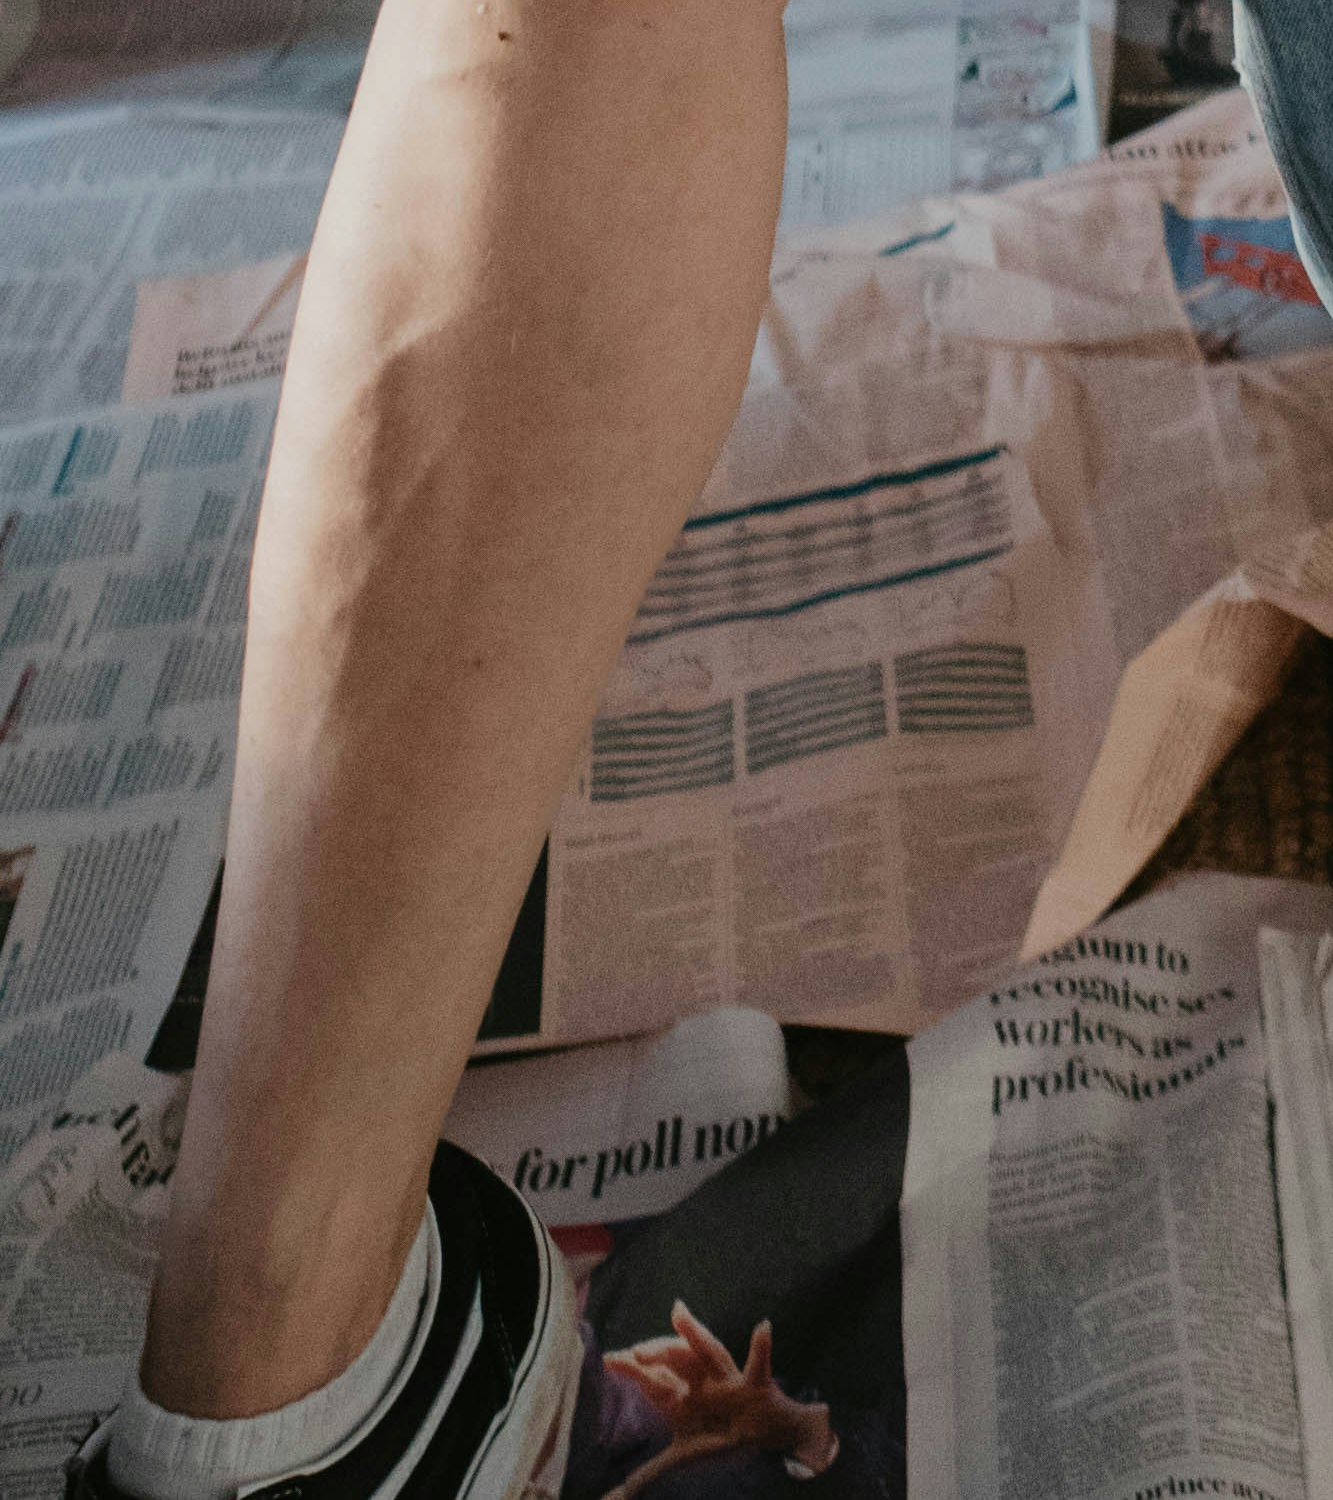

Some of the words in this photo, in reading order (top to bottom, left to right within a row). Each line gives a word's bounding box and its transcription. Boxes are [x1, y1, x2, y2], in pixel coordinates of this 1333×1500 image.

[1155, 941, 1190, 976] to
[988, 974, 1172, 1016] recognise
[993, 1007, 1146, 1061] workers
[1151, 1032, 1197, 1061] as
[990, 1032, 1247, 1117] professionals
[511, 1145, 589, 1195] for
[589, 1115, 684, 1200] poll
